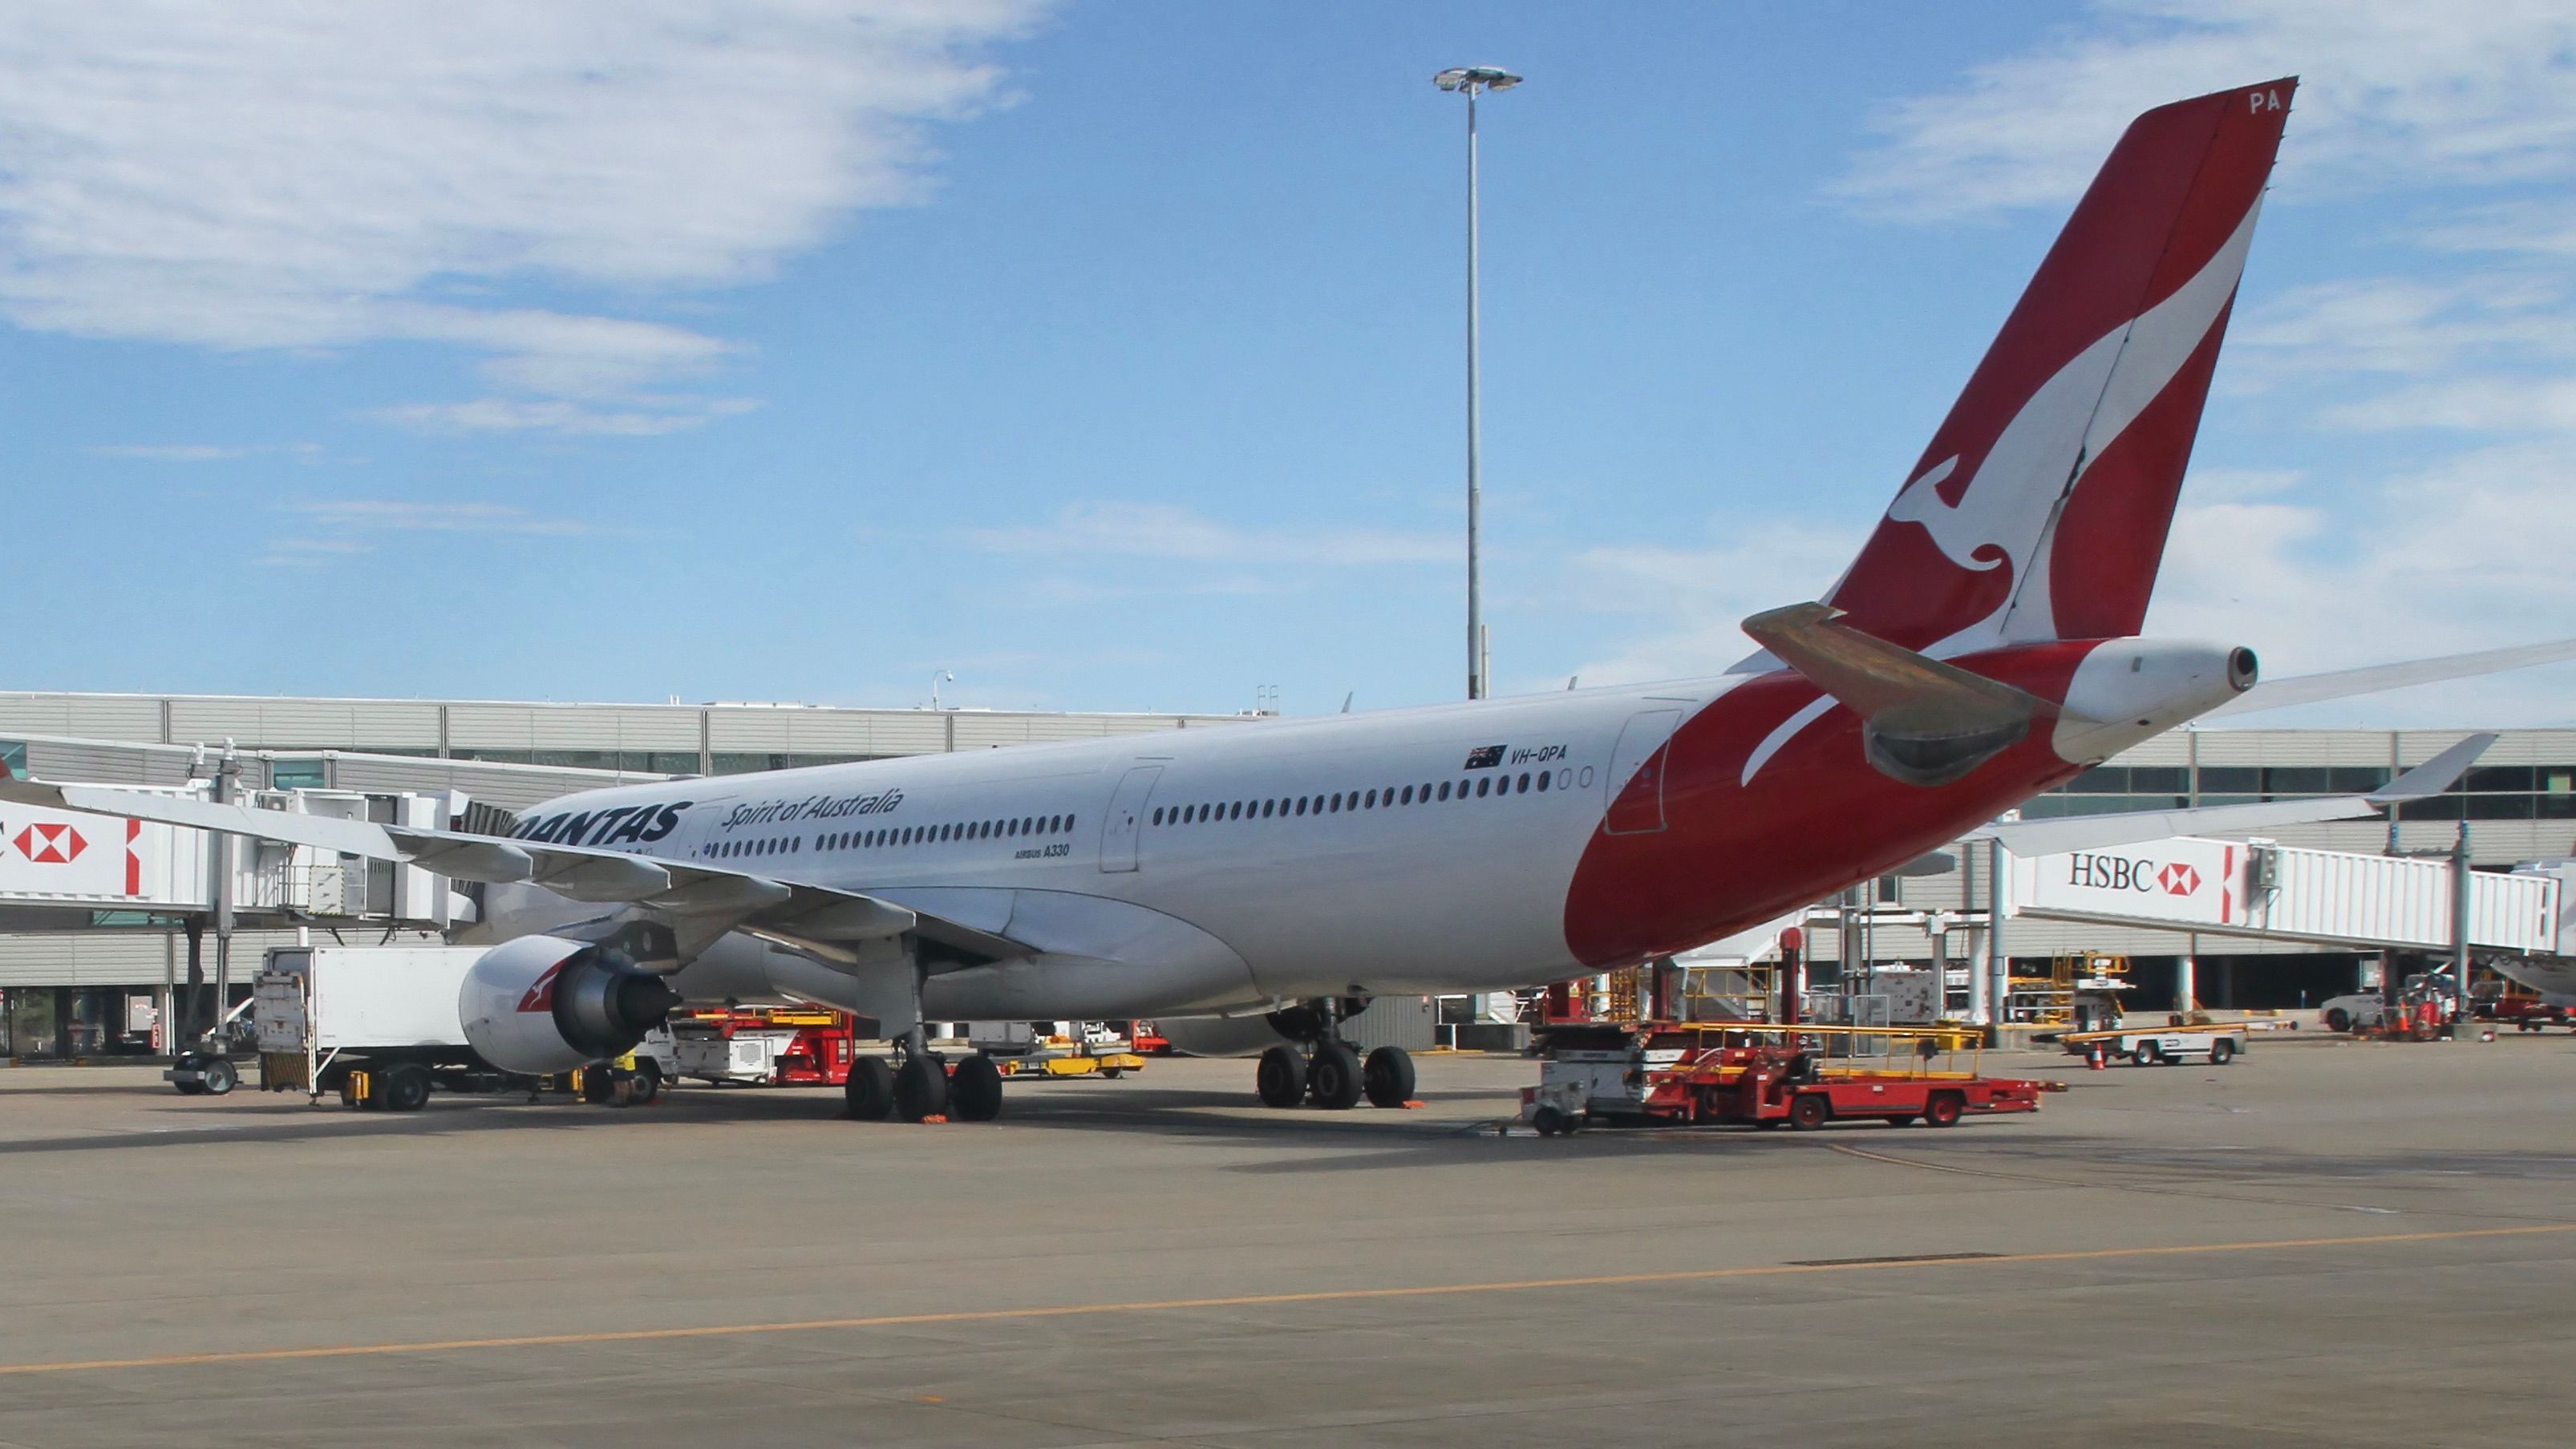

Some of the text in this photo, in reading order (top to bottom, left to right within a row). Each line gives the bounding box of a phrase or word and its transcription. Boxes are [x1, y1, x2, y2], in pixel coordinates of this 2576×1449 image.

[2250, 90, 2280, 114] PA
[1511, 744, 1567, 765] VH-QPA
[721, 787, 904, 833] Spirit of Australia
[1043, 843, 1070, 857] A330
[2068, 852, 2153, 892] HSBC
